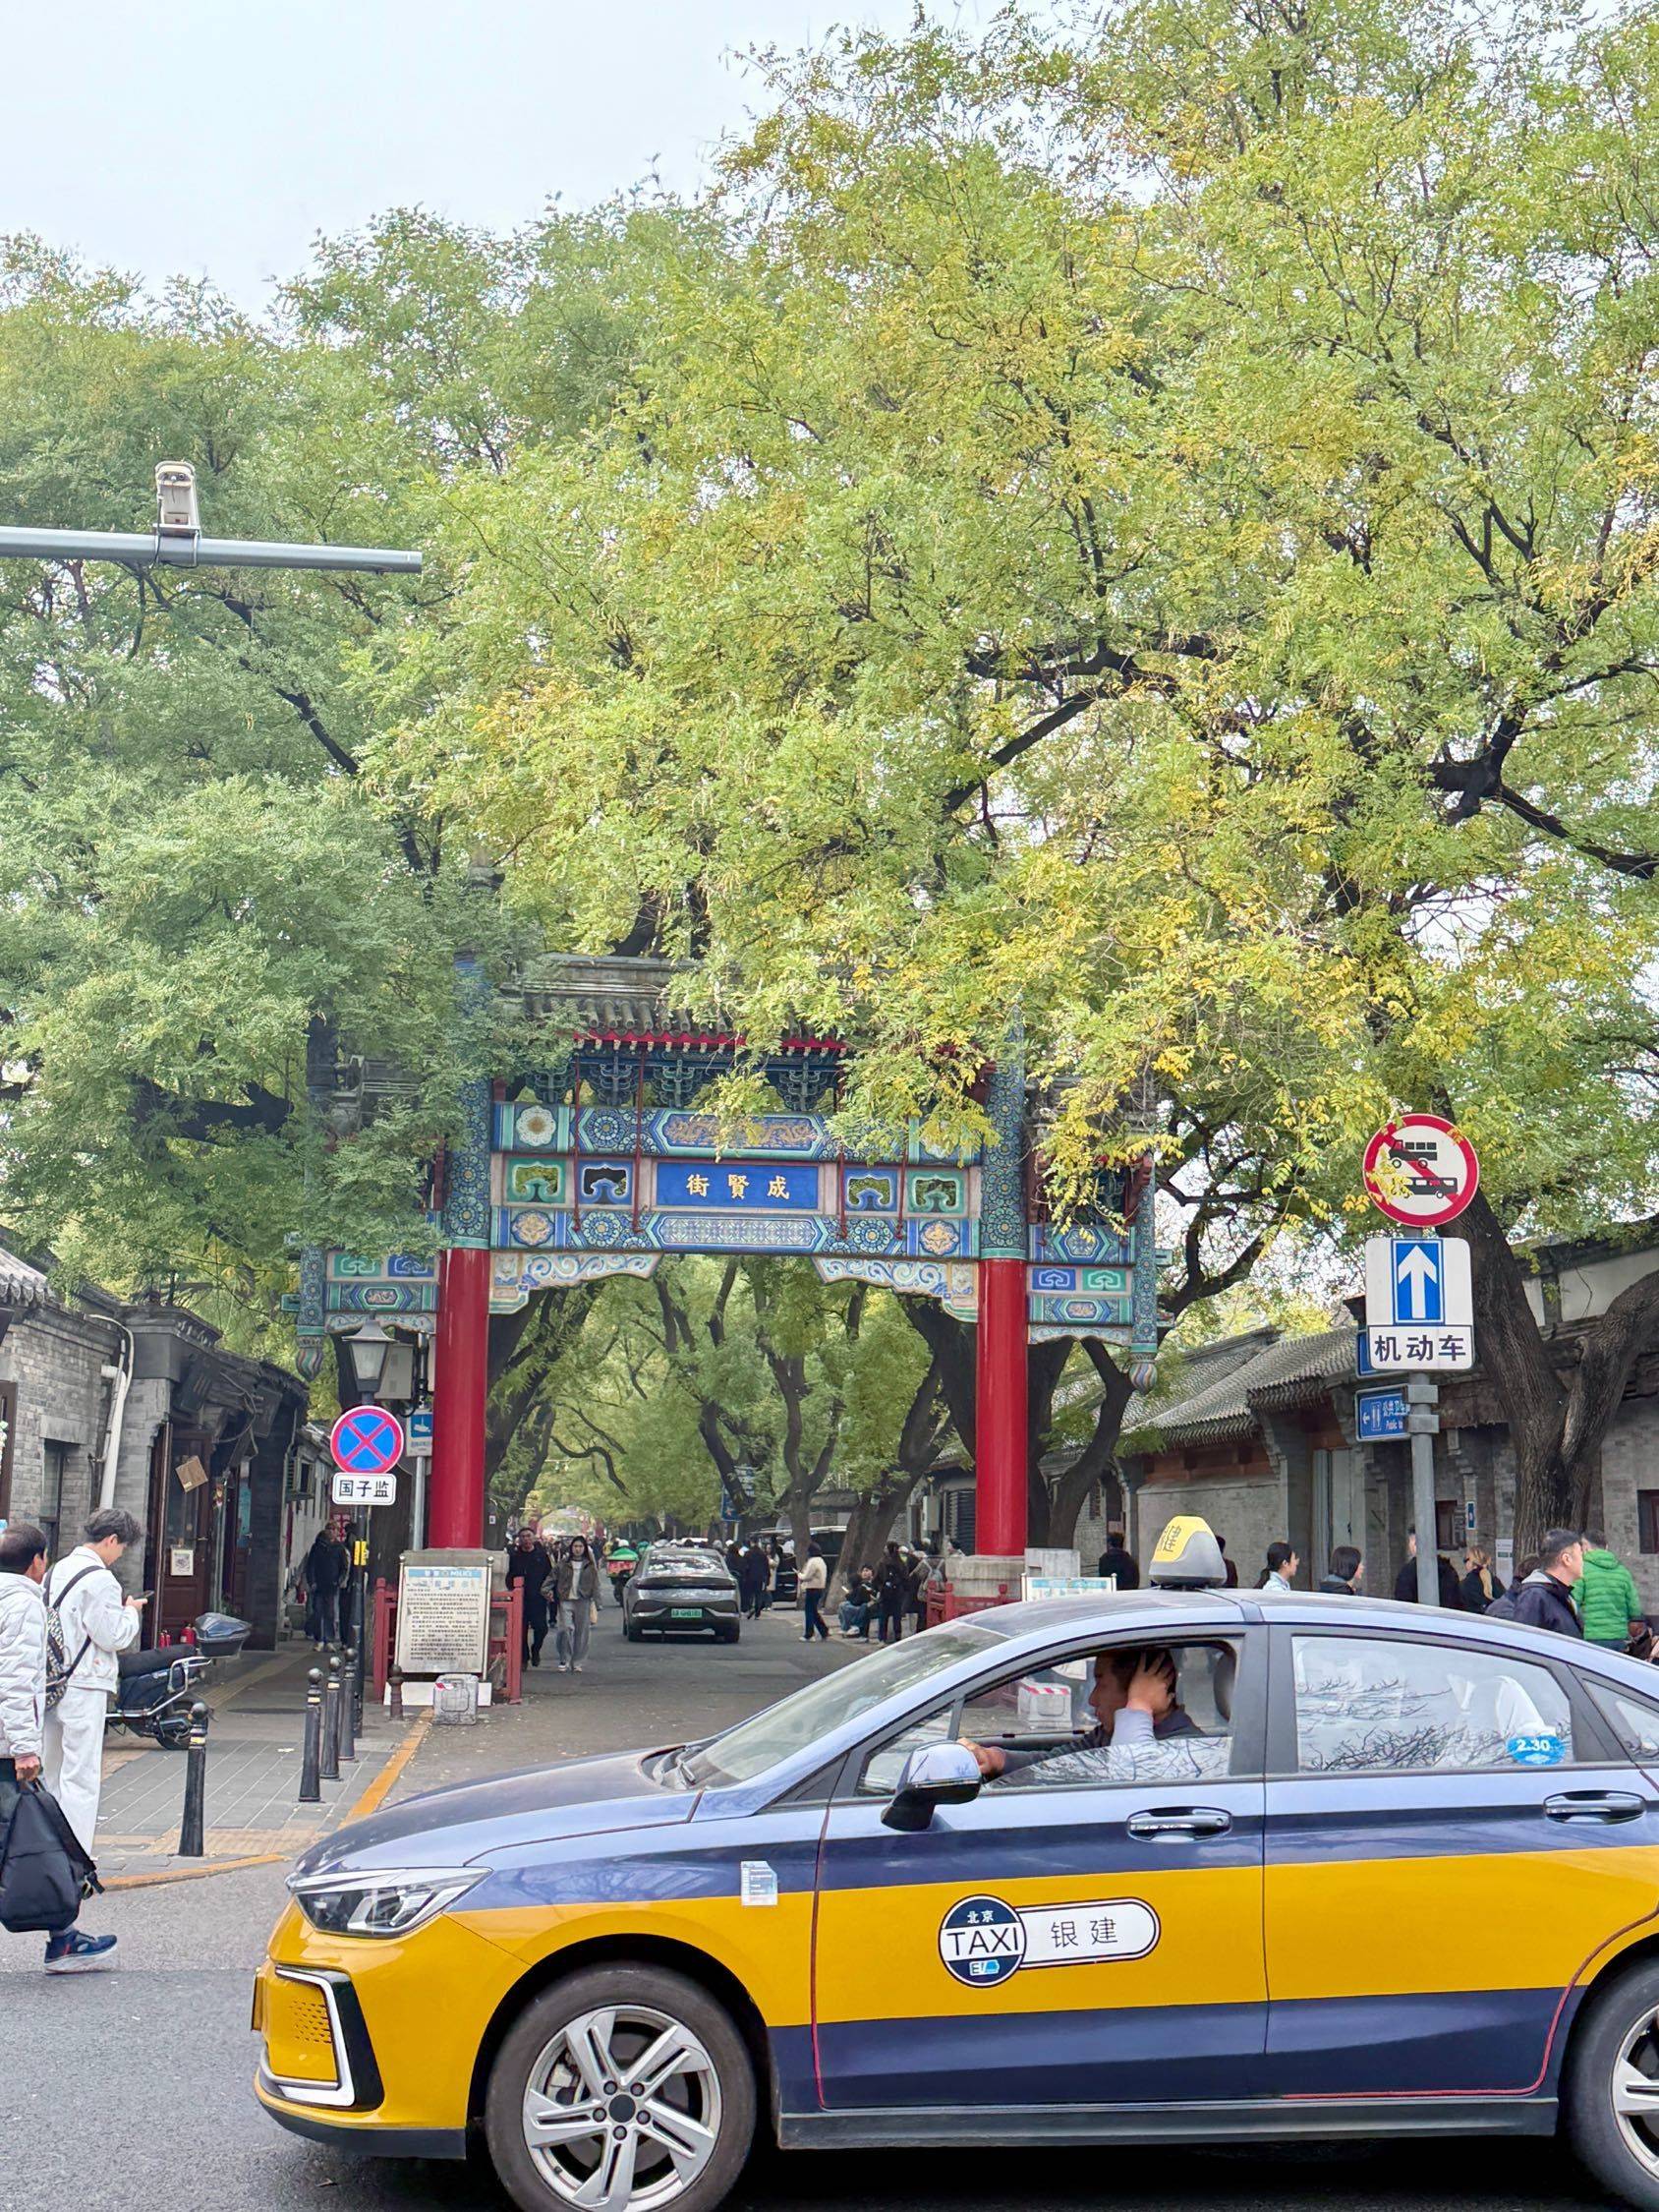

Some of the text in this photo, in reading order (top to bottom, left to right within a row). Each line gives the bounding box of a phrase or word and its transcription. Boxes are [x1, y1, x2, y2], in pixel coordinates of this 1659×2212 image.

[1375, 1335, 1466, 1362] 机动车
[339, 1480, 389, 1497] 国子监
[1516, 1739, 1551, 1752] 2.30
[967, 1909, 994, 1924] 北京
[946, 1927, 1019, 1956] TAXI
[1051, 1916, 1118, 1948] 银建
